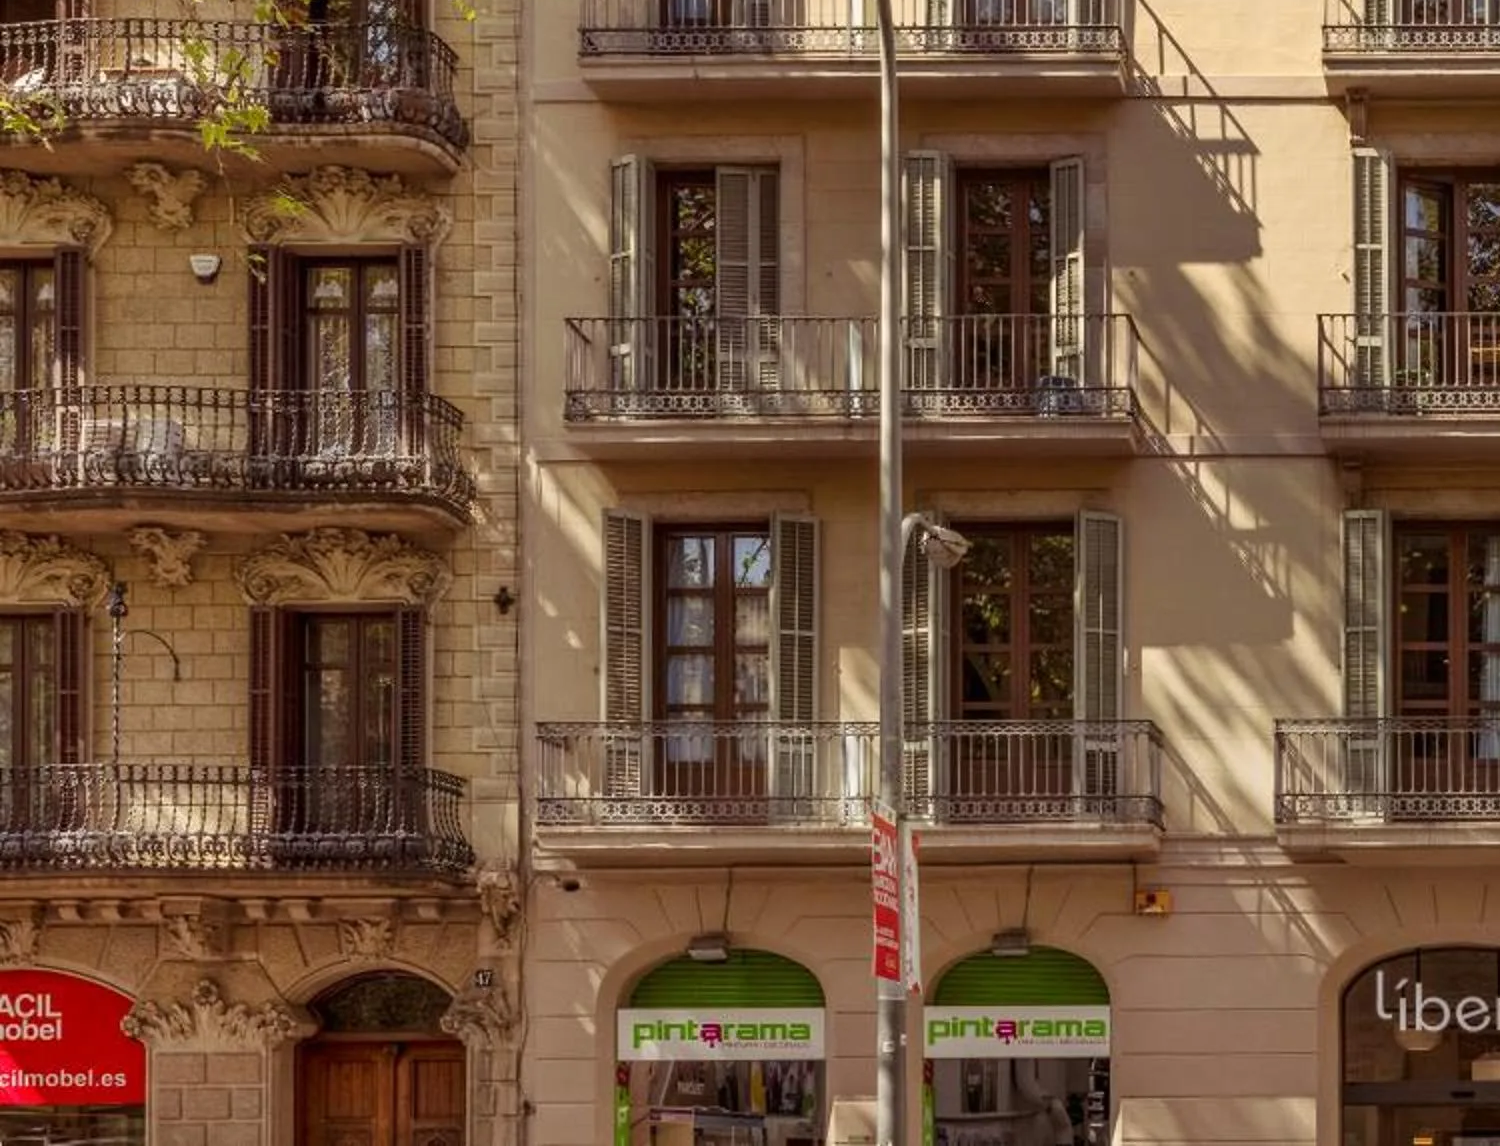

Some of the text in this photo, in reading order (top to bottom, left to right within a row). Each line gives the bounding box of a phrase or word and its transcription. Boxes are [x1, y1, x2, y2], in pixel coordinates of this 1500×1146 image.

[0, 1018, 62, 1041] obel
[633, 1019, 811, 1048] pintarama
[928, 1016, 1106, 1045] pintarama
